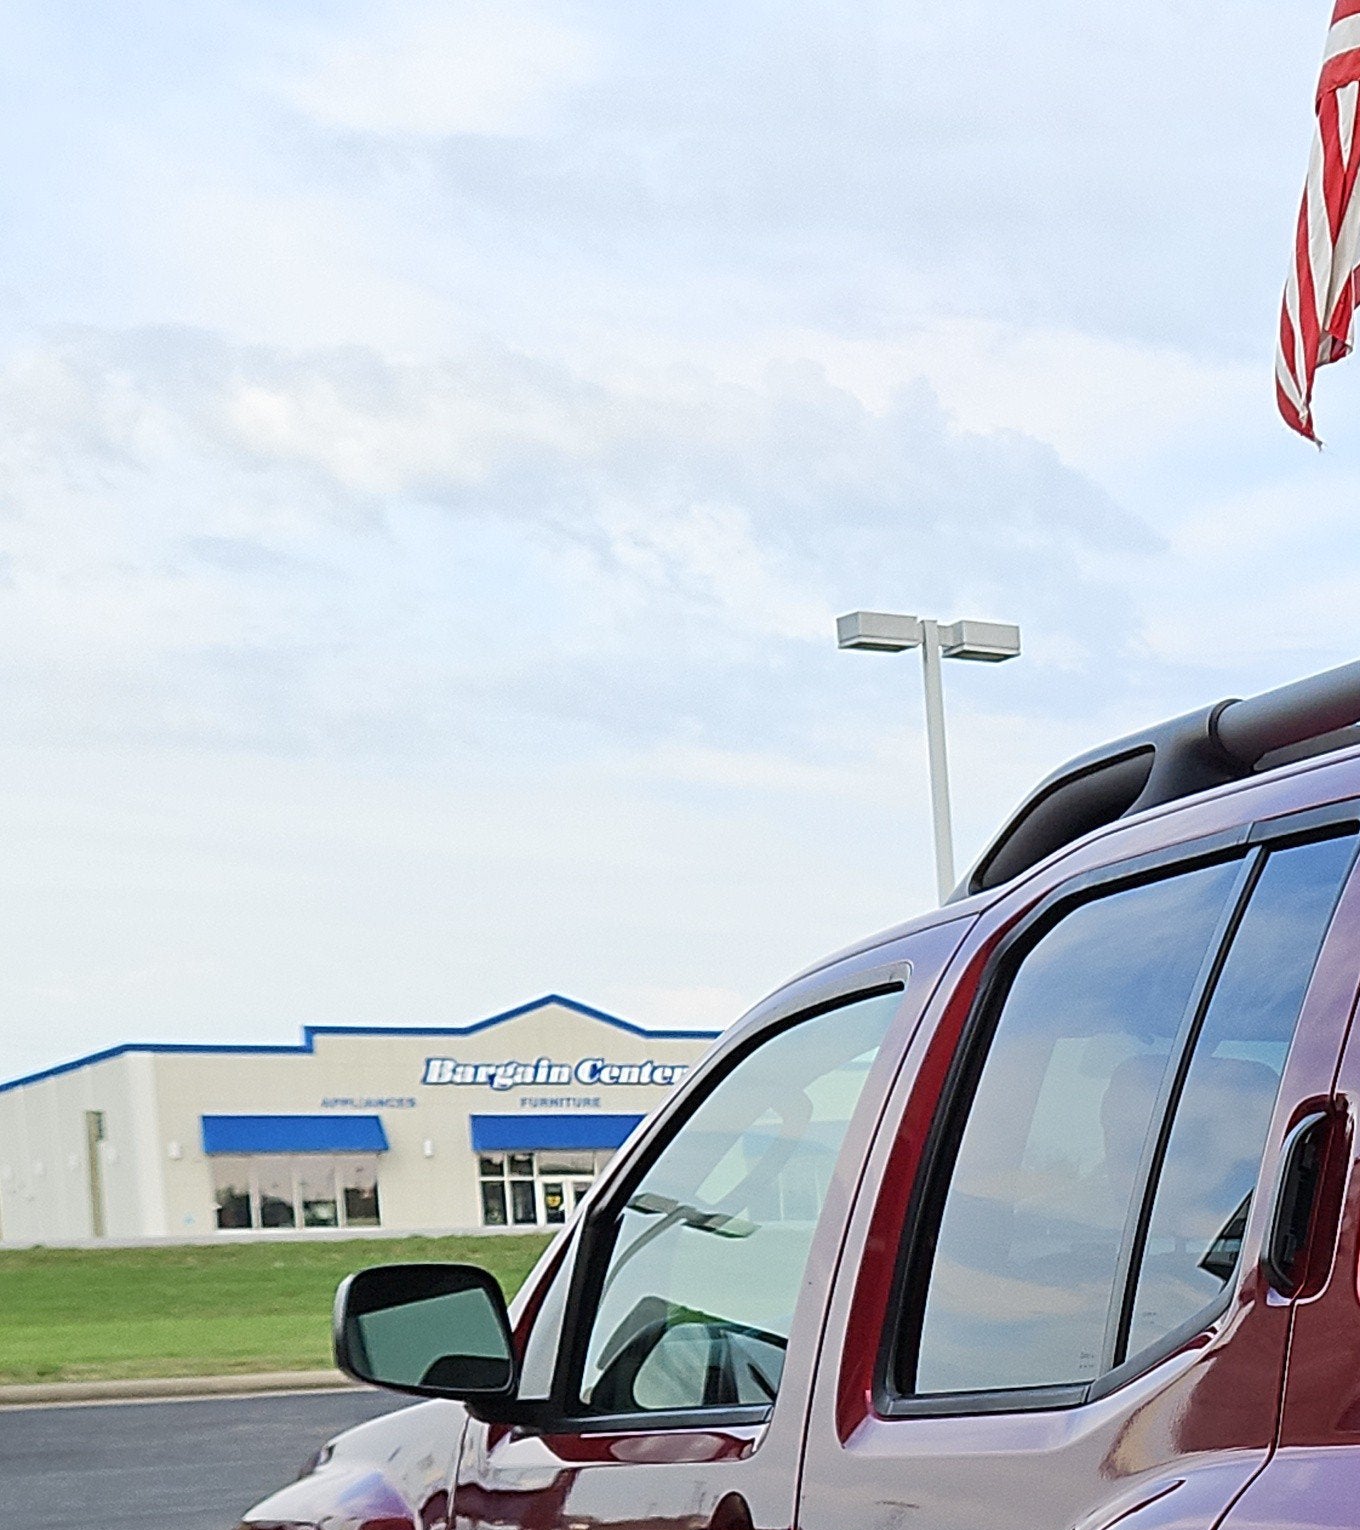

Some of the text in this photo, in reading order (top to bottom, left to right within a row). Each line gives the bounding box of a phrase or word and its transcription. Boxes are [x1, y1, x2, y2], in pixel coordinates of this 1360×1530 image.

[422, 1057, 689, 1091] Bargain Center
[520, 1097, 601, 1108] FURNITURE
